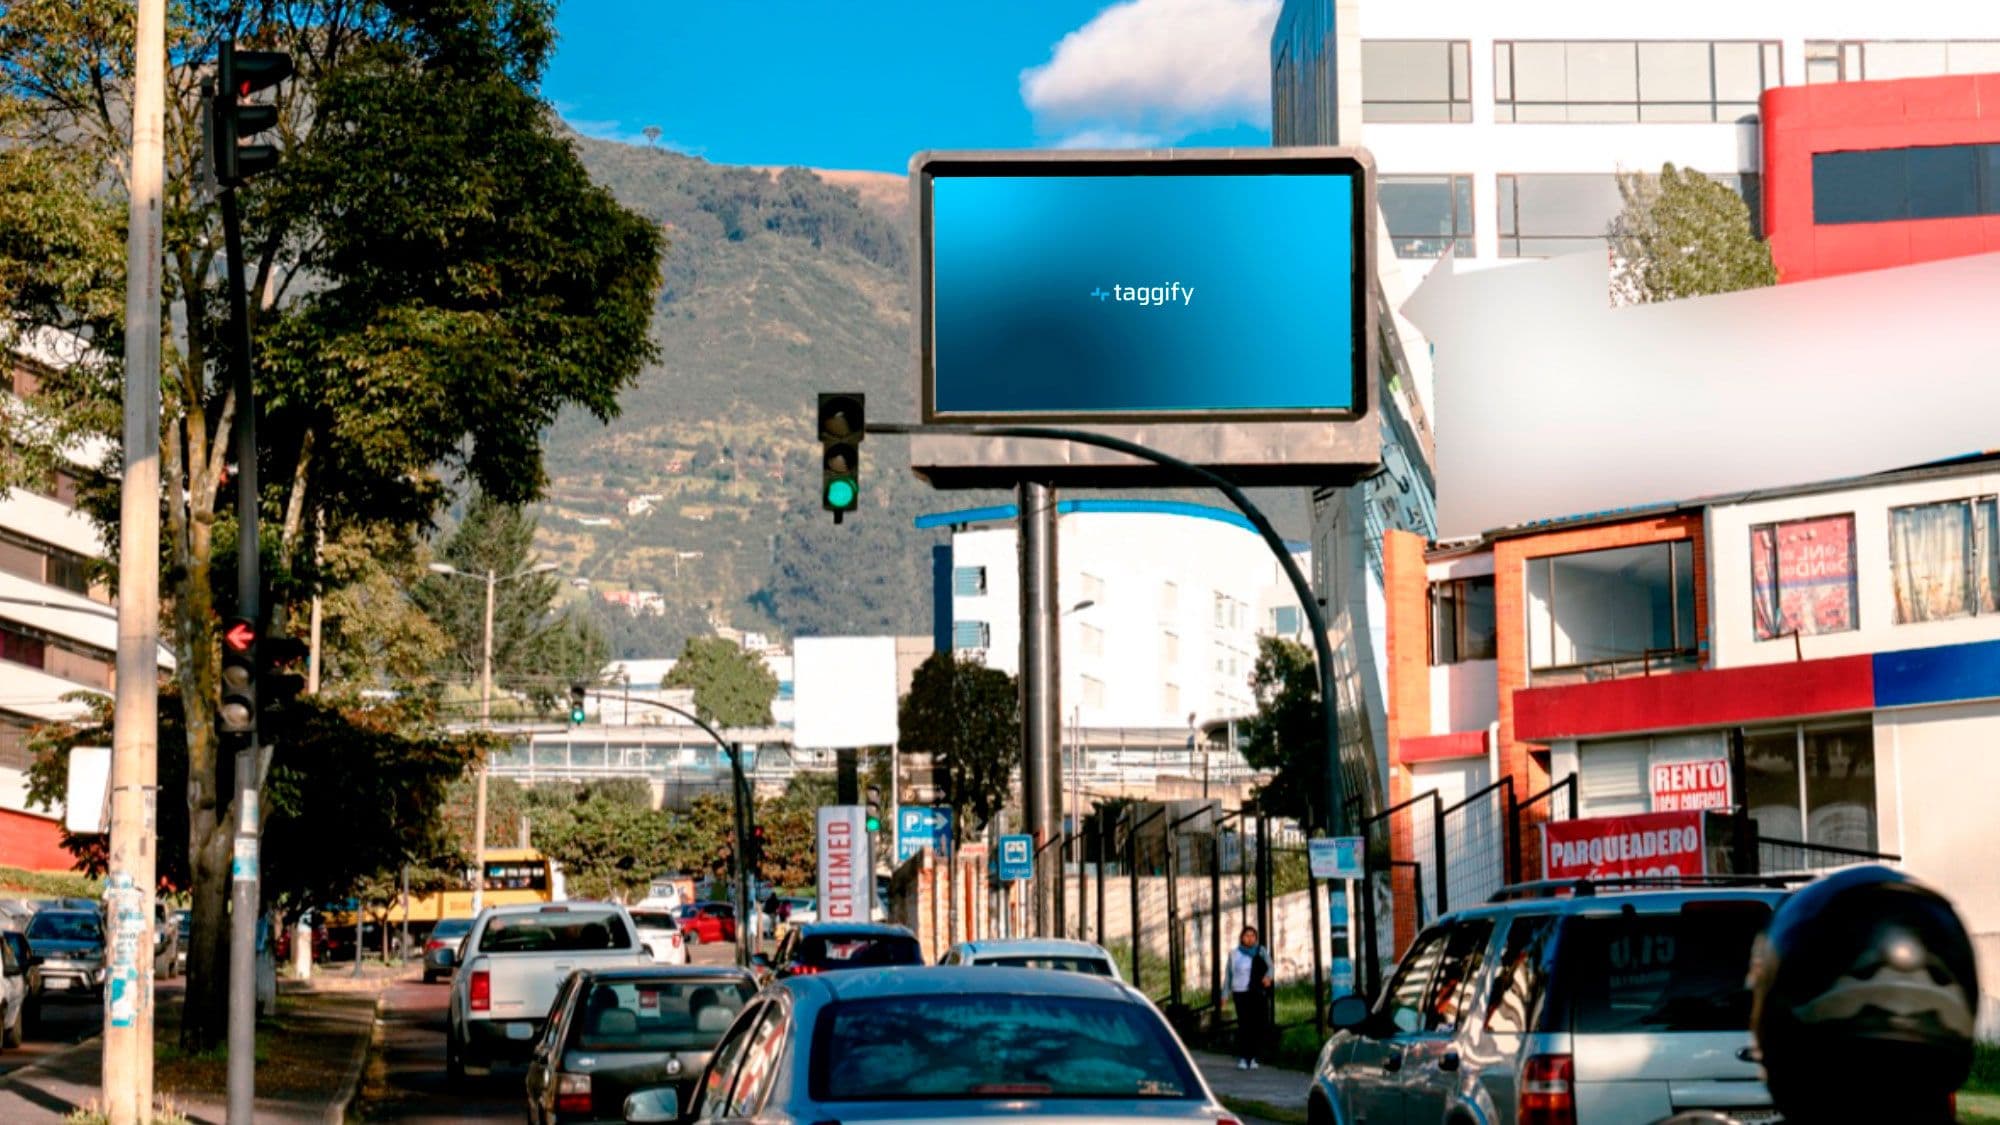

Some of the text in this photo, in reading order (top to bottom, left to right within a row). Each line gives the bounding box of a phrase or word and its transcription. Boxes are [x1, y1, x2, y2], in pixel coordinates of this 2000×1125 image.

[1114, 281, 1194, 306] taggify
[1656, 761, 1726, 793] RENTO
[1551, 825, 1699, 868] PARQUEADERO
[827, 821, 853, 918] CITIMED
